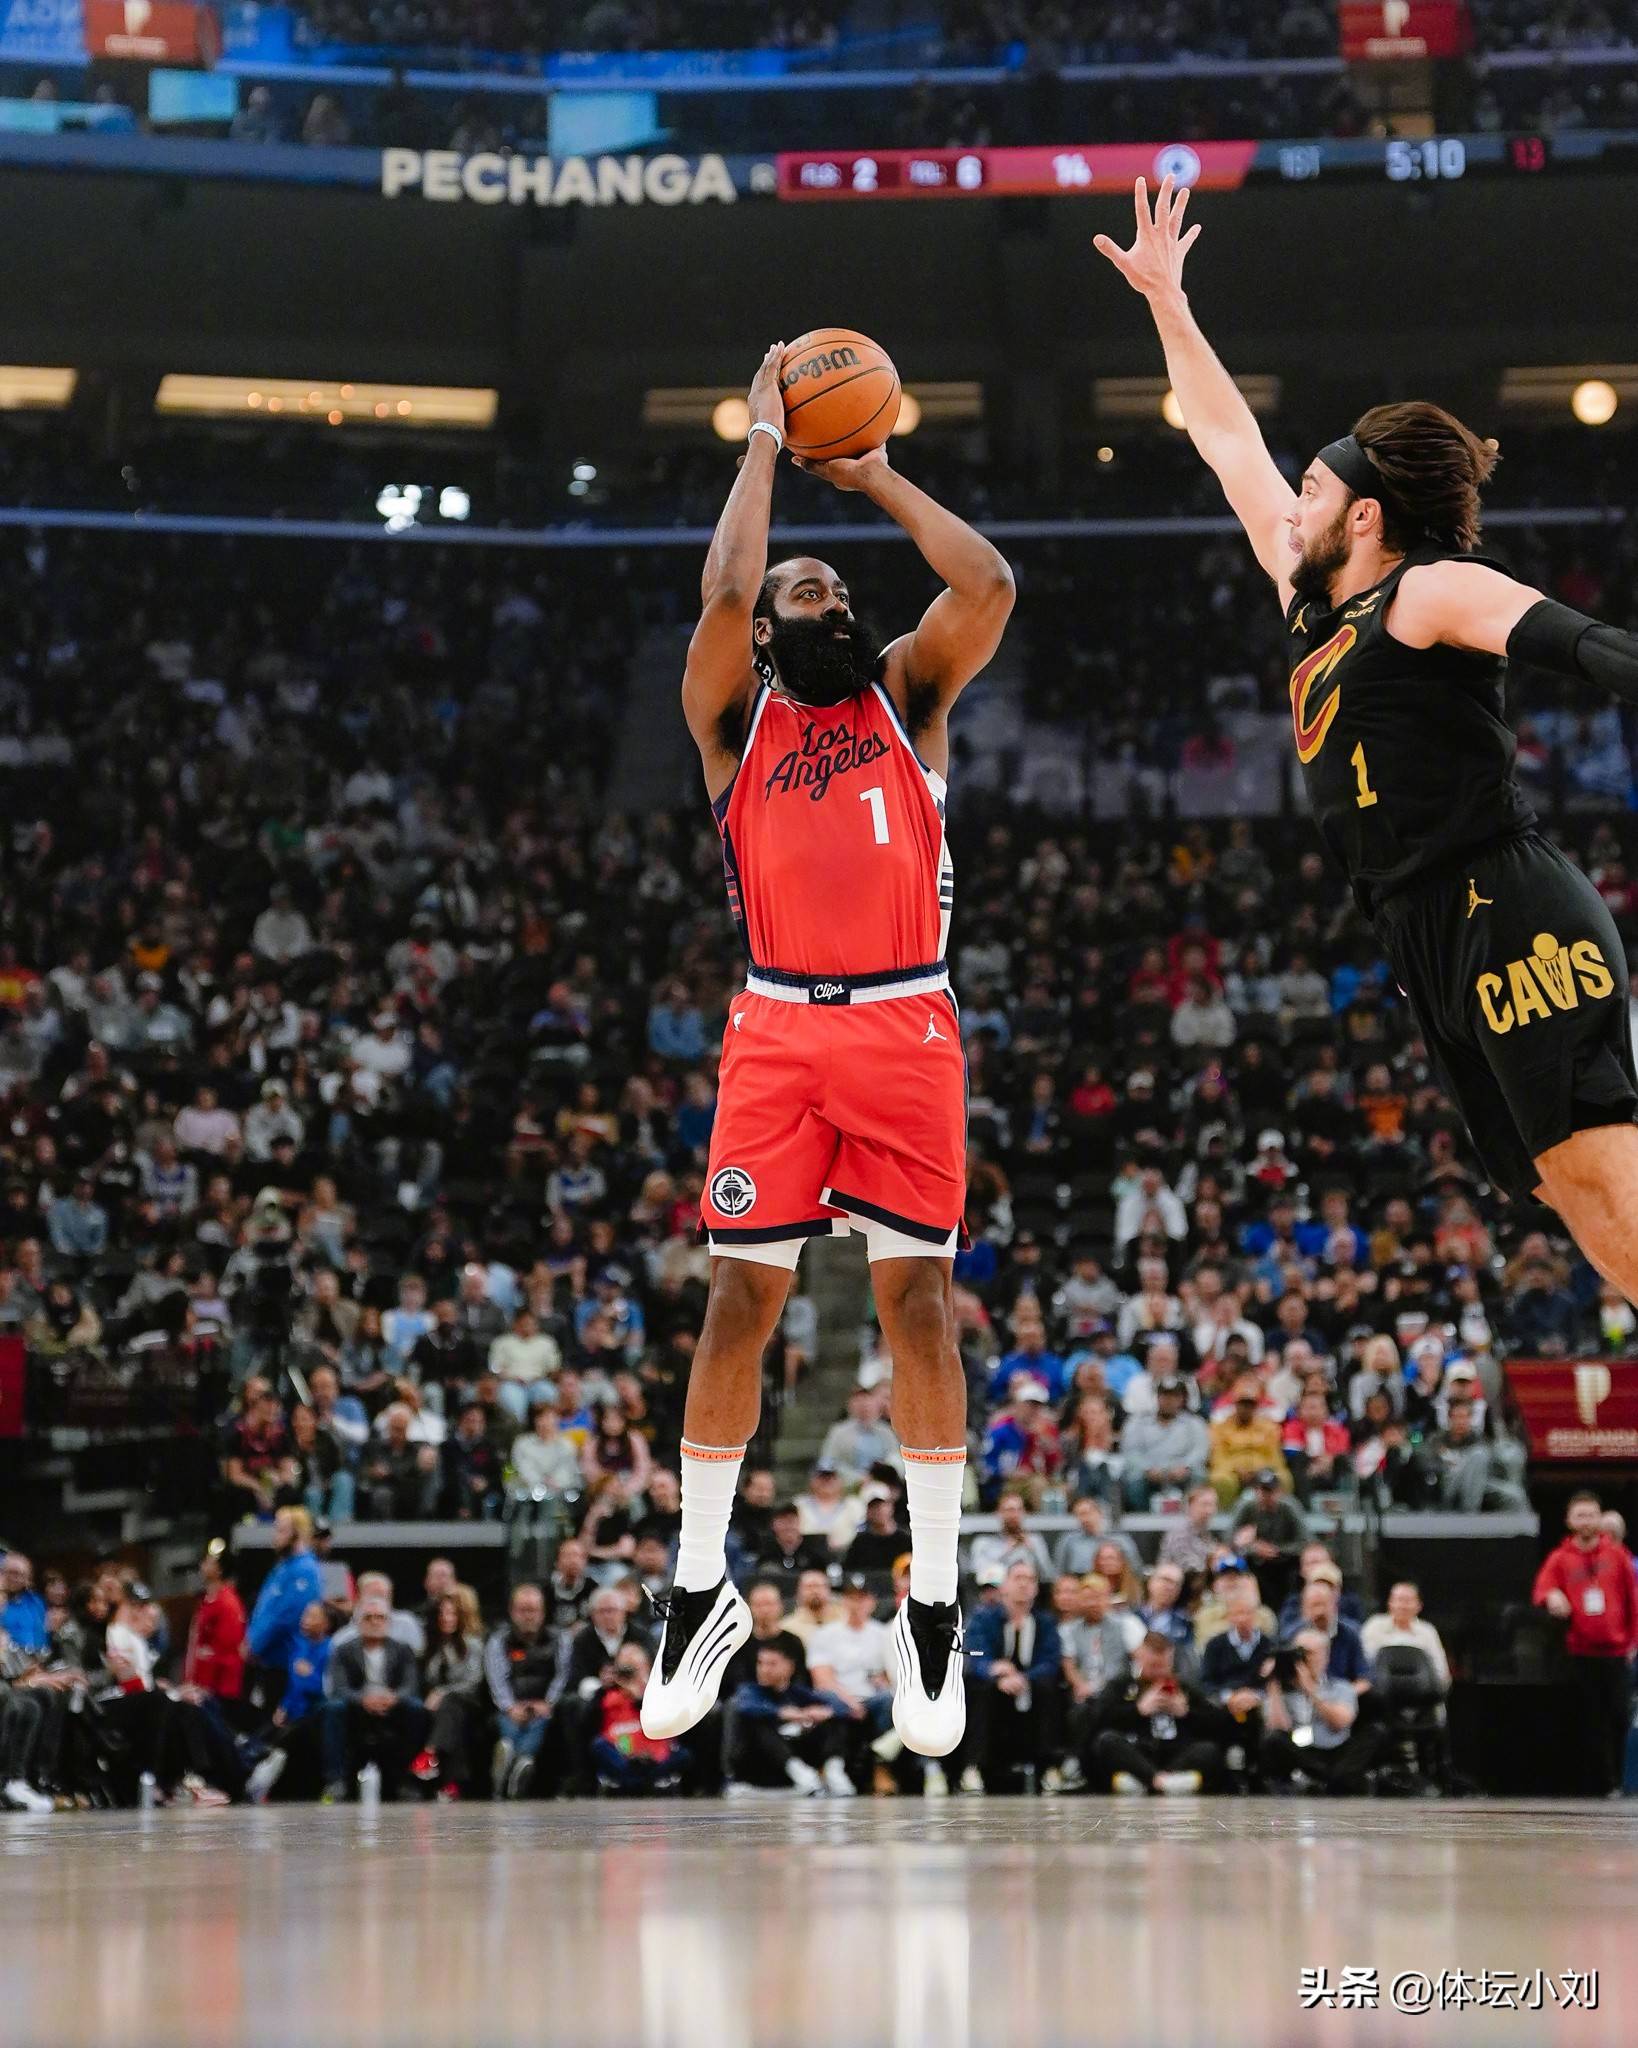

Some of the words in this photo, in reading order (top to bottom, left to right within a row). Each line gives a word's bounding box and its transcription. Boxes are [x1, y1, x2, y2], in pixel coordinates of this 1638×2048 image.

[381, 147, 738, 206] PECHANGA
[1386, 140, 1466, 181] 5:10
[765, 732, 890, 802] Angeles
[802, 721, 856, 758] Los
[1351, 741, 1378, 808] 1
[859, 786, 890, 845] 1
[813, 982, 845, 1000] Clips
[1476, 934, 1614, 1034] CAVS
